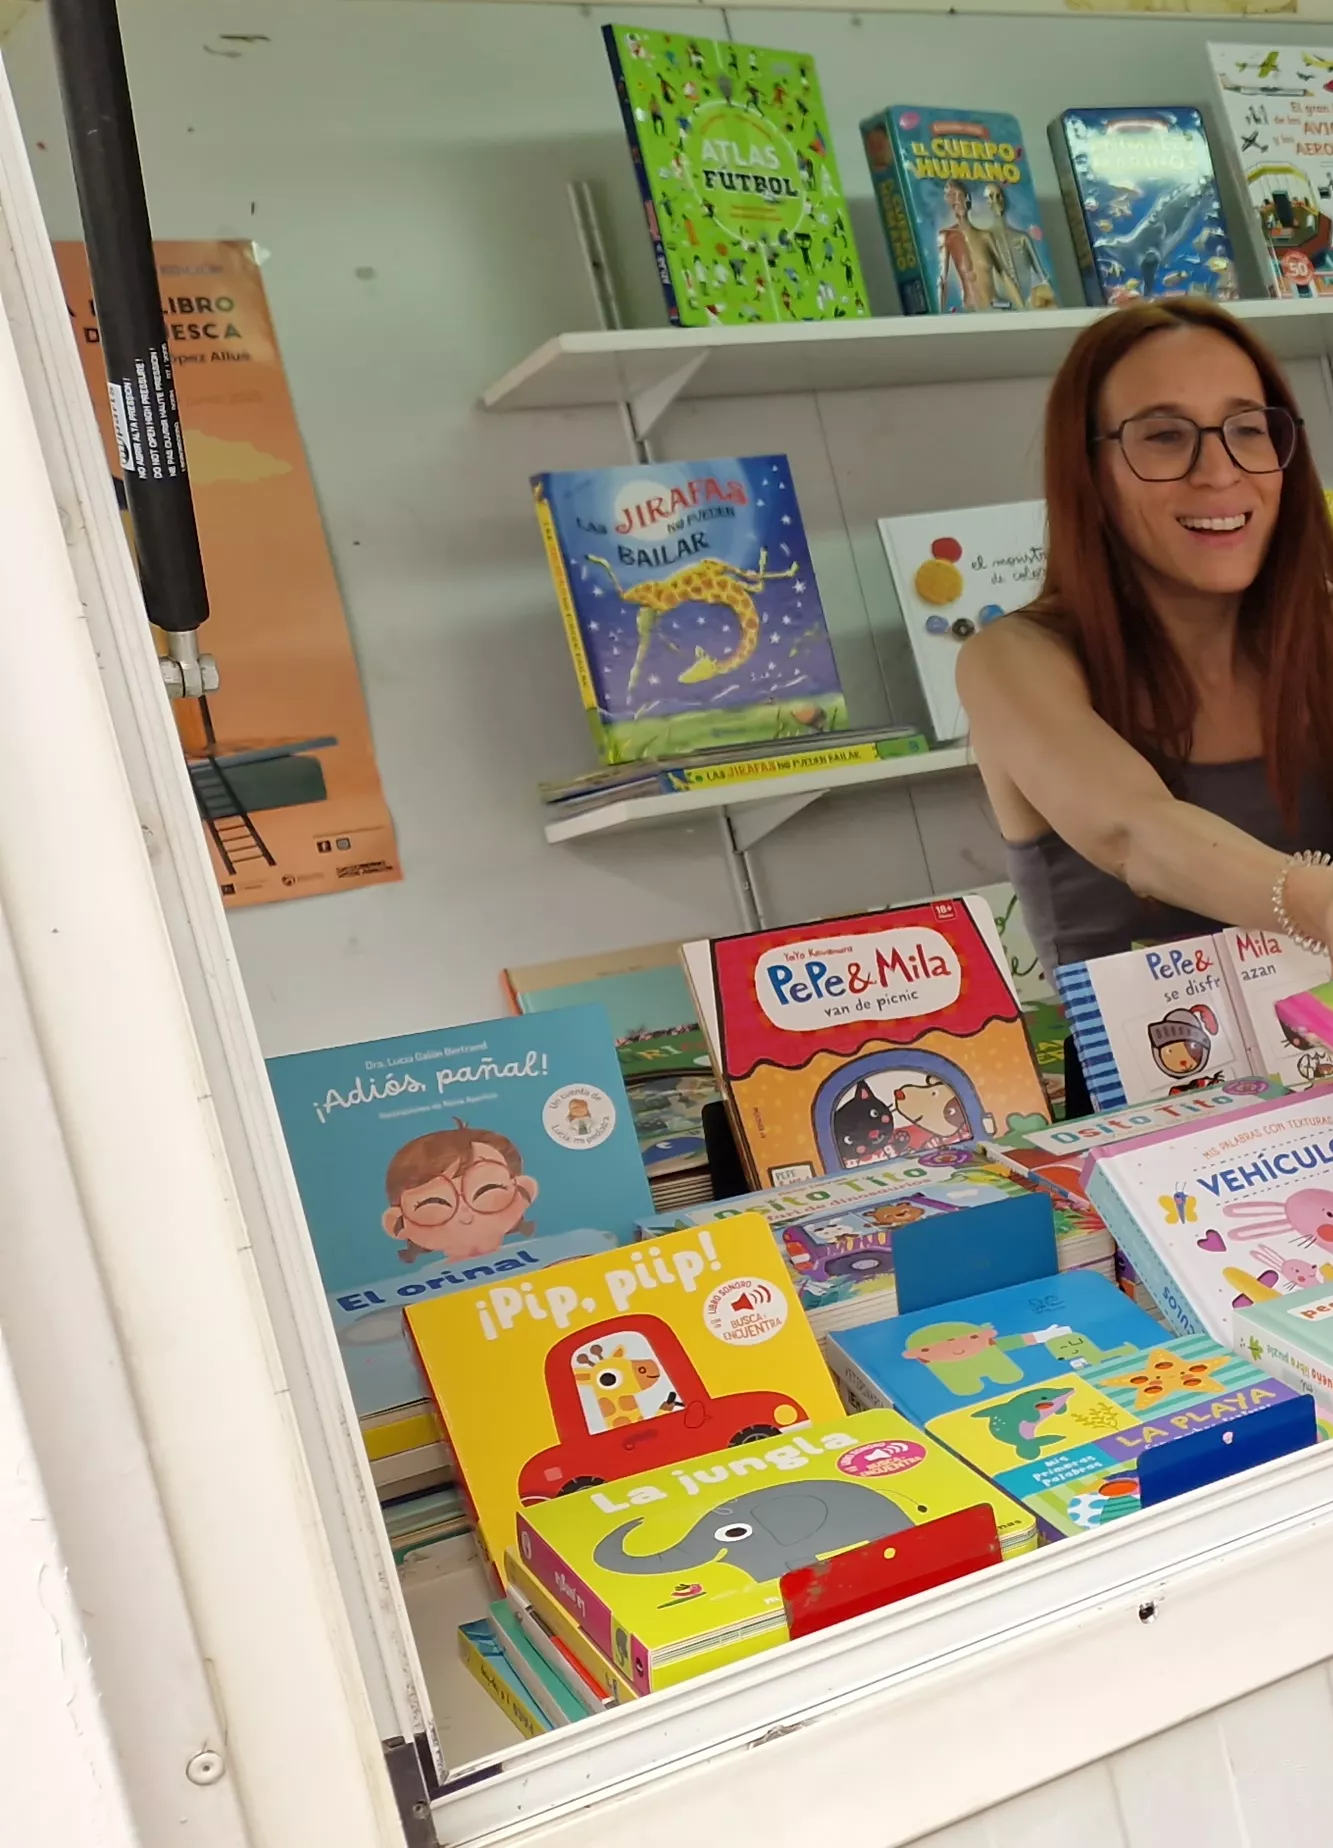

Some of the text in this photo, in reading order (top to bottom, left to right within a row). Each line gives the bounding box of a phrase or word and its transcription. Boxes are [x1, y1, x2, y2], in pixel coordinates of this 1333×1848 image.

[702, 139, 781, 170] ATLAS
[930, 138, 1017, 163] CUERPO
[702, 163, 799, 198] FÚTBOL
[914, 160, 1021, 184] HUMANO
[146, 426, 159, 449] OPEN
[614, 477, 749, 536] JIRAFAS
[617, 531, 710, 570] BAILAR
[705, 768, 728, 782] LAS
[727, 759, 778, 778] JIRAFAS
[1235, 931, 1283, 962] Mila
[874, 942, 953, 988] Mila
[1163, 963, 1277, 1003] se disfr azan
[823, 988, 920, 1018] van de picnic
[312, 1068, 427, 1124] ¡Adiós,
[435, 1051, 549, 1095] pañal!
[1050, 1094, 1235, 1145] Osito Tito
[1202, 1145, 1220, 1162] MIS
[1219, 1128, 1263, 1153] PALABRAS
[1262, 1121, 1287, 1137] CON
[803, 1203, 827, 1214] de
[829, 1178, 932, 1208] dinosaurios
[838, 1166, 929, 1193] Tito
[336, 1249, 541, 1313] El orinal
[474, 1229, 723, 1342] ¡Pip, piip!
[718, 1280, 753, 1297] SONORO
[722, 1317, 783, 1341] ENCUENTRA
[730, 1312, 764, 1330] BUSCA
[1115, 1426, 1169, 1447] LA
[1169, 1387, 1277, 1430] PLAYA
[590, 1482, 668, 1517] La
[671, 1428, 860, 1497] jungla
